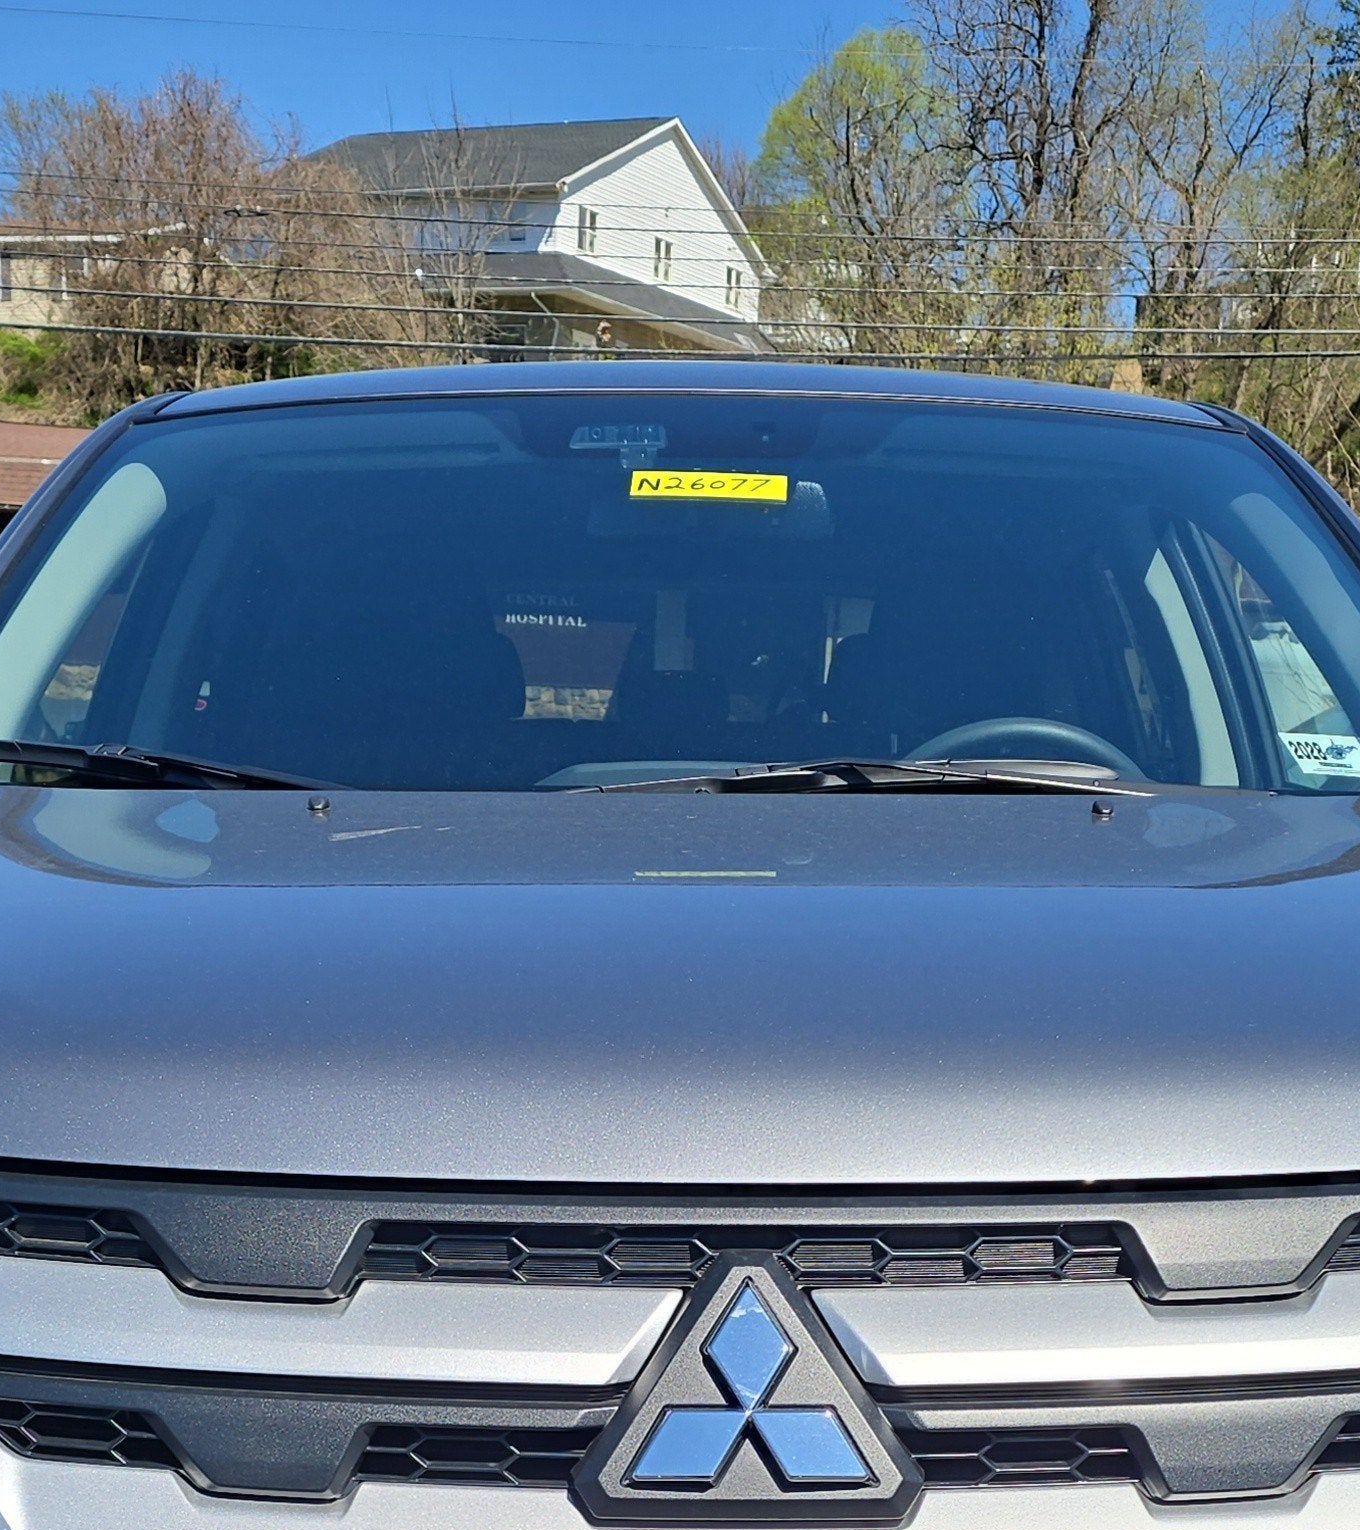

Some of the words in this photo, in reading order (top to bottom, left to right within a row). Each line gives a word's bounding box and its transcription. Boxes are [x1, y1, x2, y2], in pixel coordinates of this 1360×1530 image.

[637, 477, 771, 492] N26077
[505, 613, 587, 627] HOSPITAL
[1288, 740, 1328, 761] 2028
